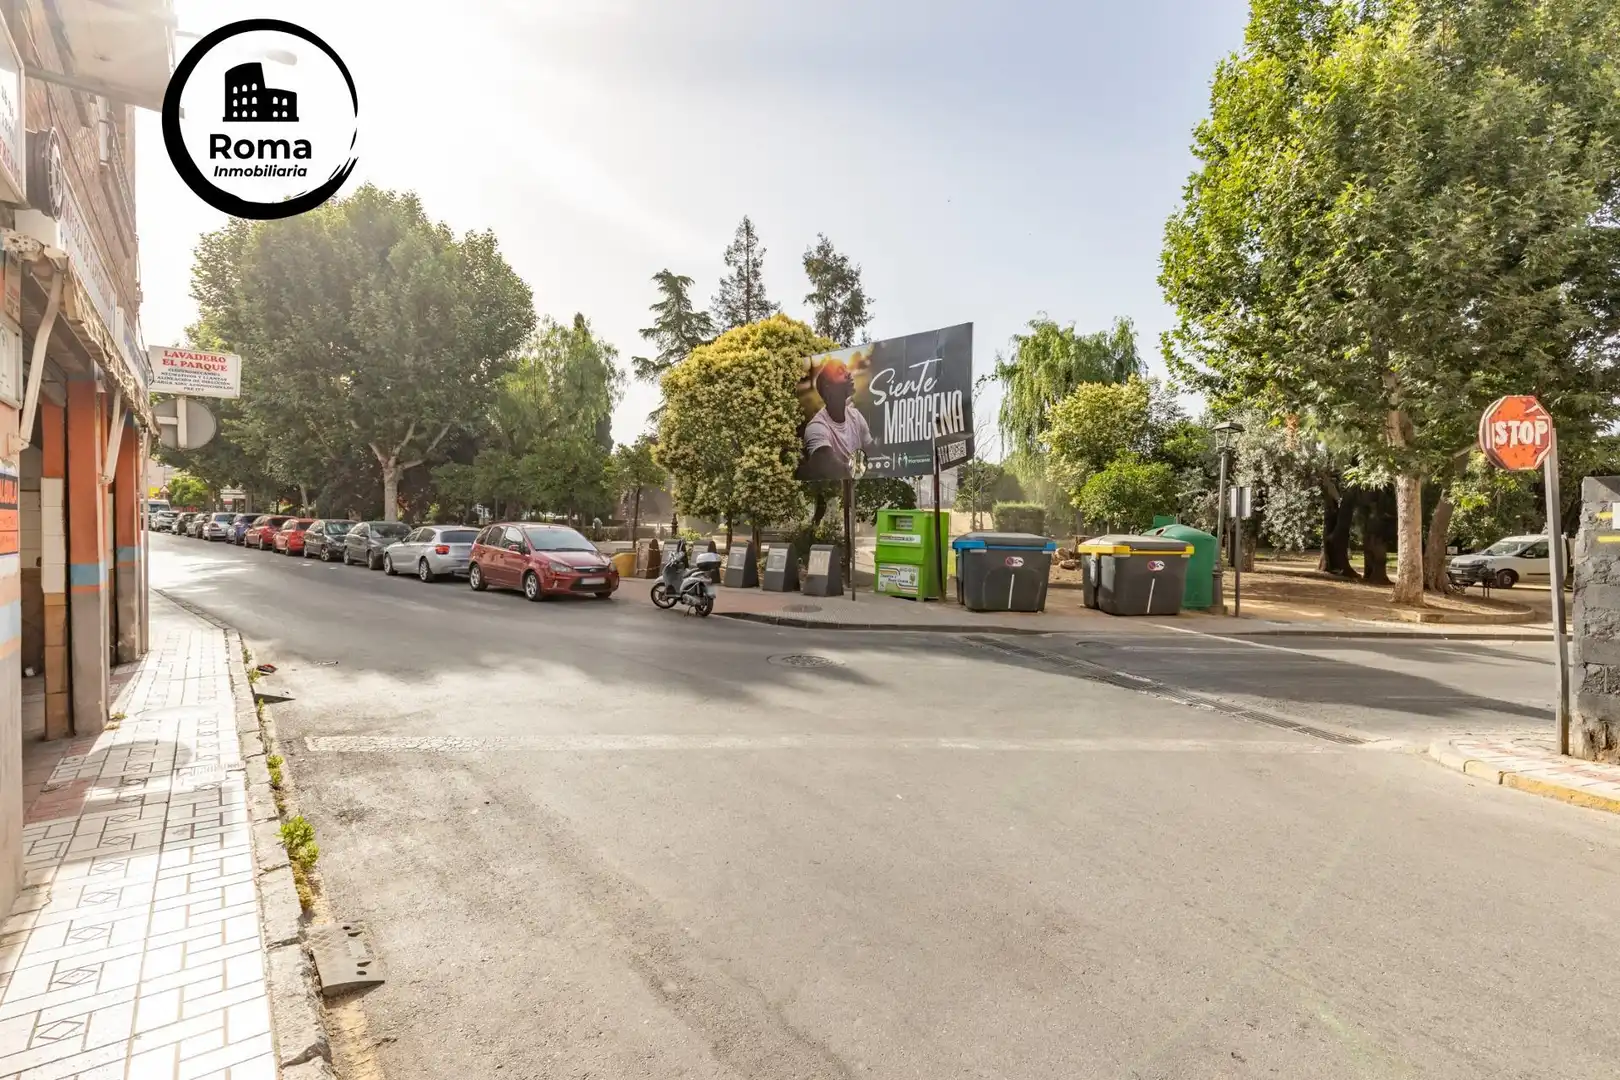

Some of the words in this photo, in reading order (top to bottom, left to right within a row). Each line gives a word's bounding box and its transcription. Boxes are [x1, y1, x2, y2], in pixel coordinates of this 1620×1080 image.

[162, 358, 178, 367] EL
[180, 360, 228, 372] PARQUE
[163, 350, 227, 363] LAVADERO
[884, 389, 965, 445] MARACENA
[1494, 420, 1549, 447] STOP
